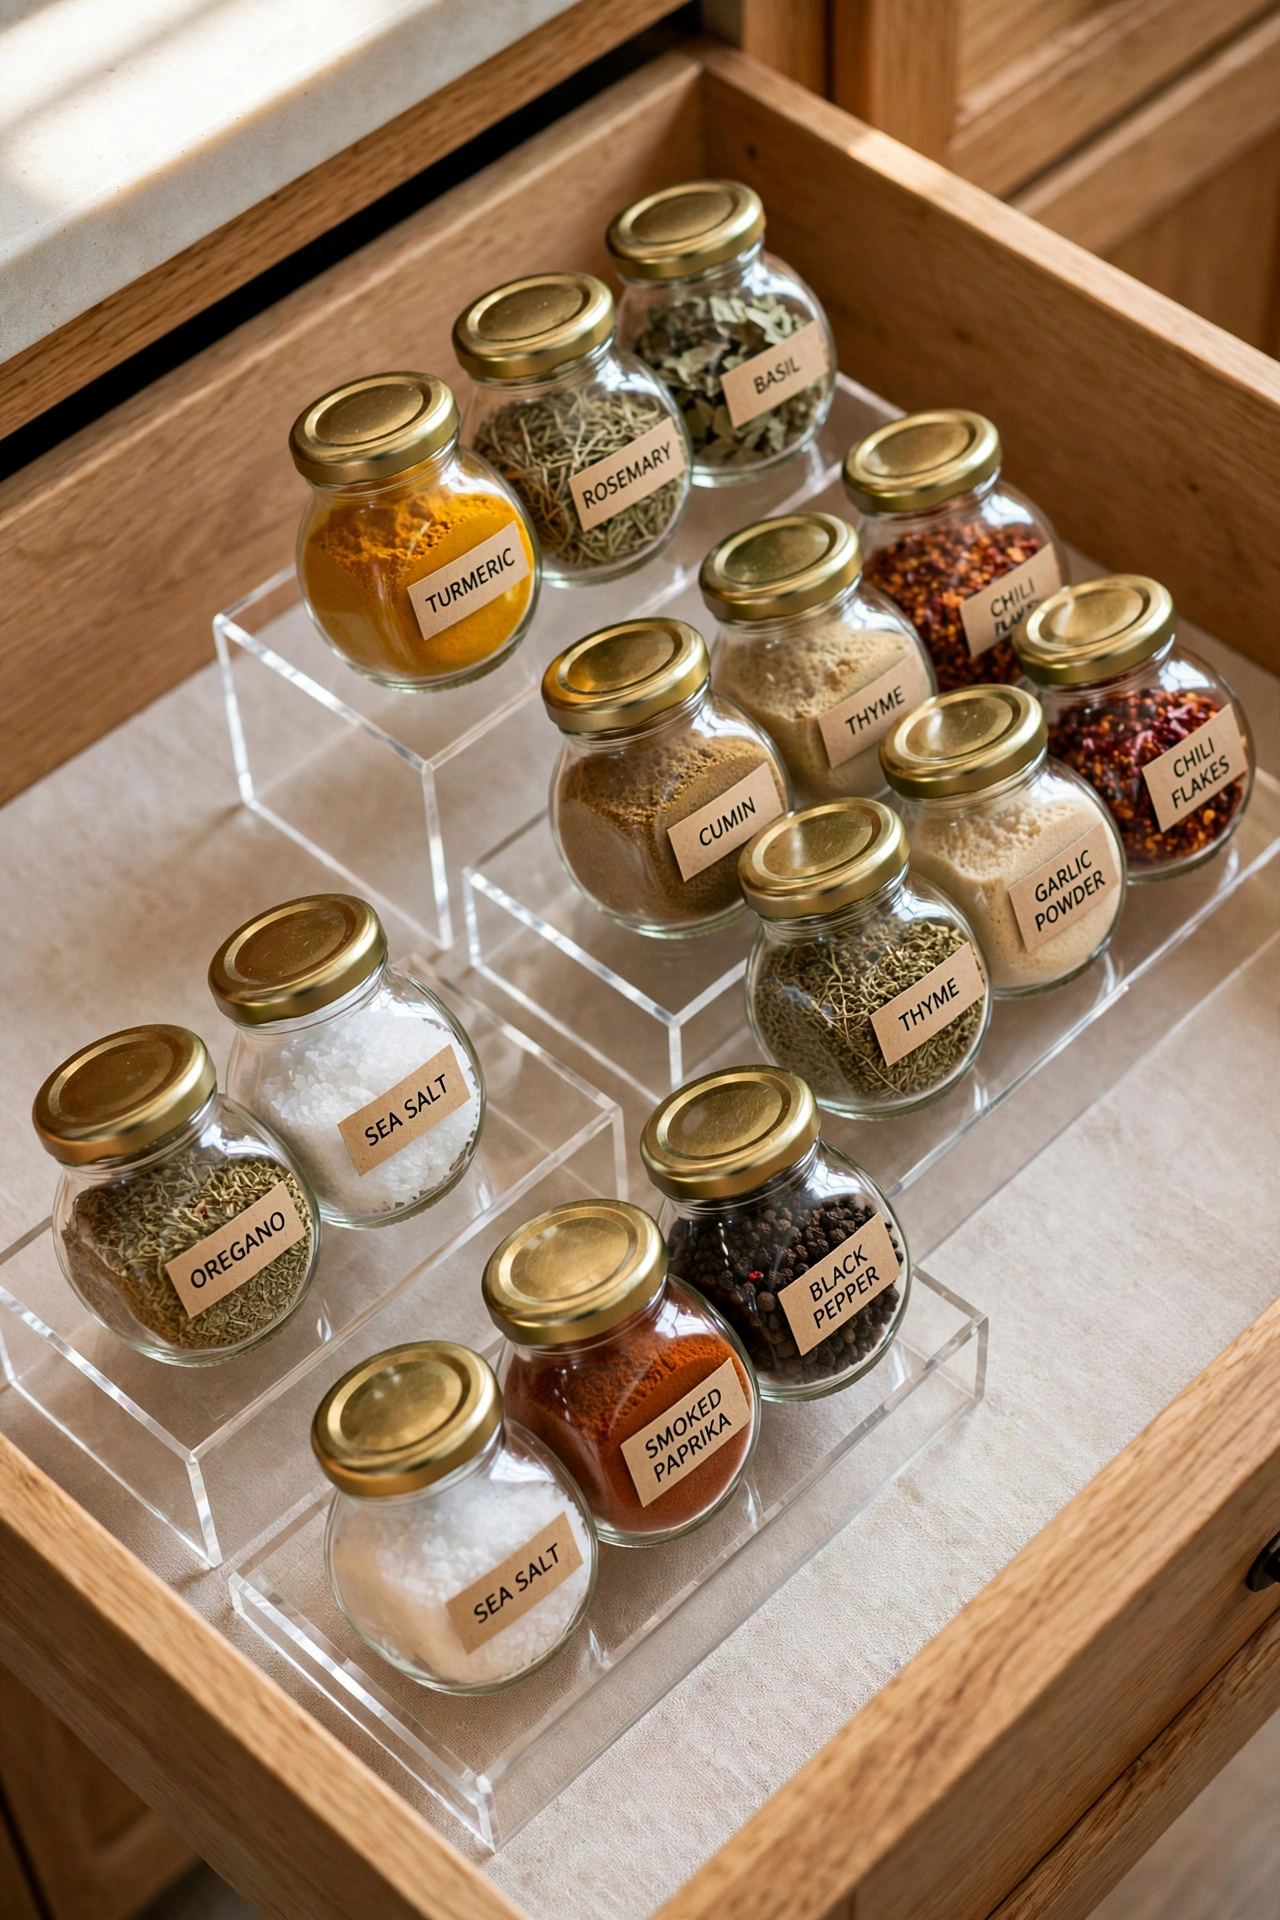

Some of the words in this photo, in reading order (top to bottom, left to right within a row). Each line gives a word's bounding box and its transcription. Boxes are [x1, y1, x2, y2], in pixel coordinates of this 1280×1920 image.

[753, 356, 800, 395] BASIL
[582, 441, 671, 510] ROSEMARY
[425, 547, 516, 613] TURMERIC
[990, 576, 1035, 617] CHILI
[844, 685, 905, 737] THYME
[1171, 755, 1230, 809] FLAKES
[1173, 737, 1214, 778] CHILI
[699, 796, 756, 847] CUMIN
[1035, 849, 1093, 903] GARLIC
[1035, 869, 1106, 932] POWDER
[898, 976, 960, 1032] THYME
[364, 1110, 404, 1147] SEA
[403, 1073, 448, 1121] SALT
[190, 1210, 286, 1289] OREGANO
[809, 1244, 869, 1303] BLACK
[813, 1265, 880, 1330] PEPPER
[645, 1388, 722, 1459] SMOKED
[653, 1412, 732, 1483] PAPRIKA
[473, 1585, 514, 1625] SEA
[514, 1543, 561, 1593] SALT
